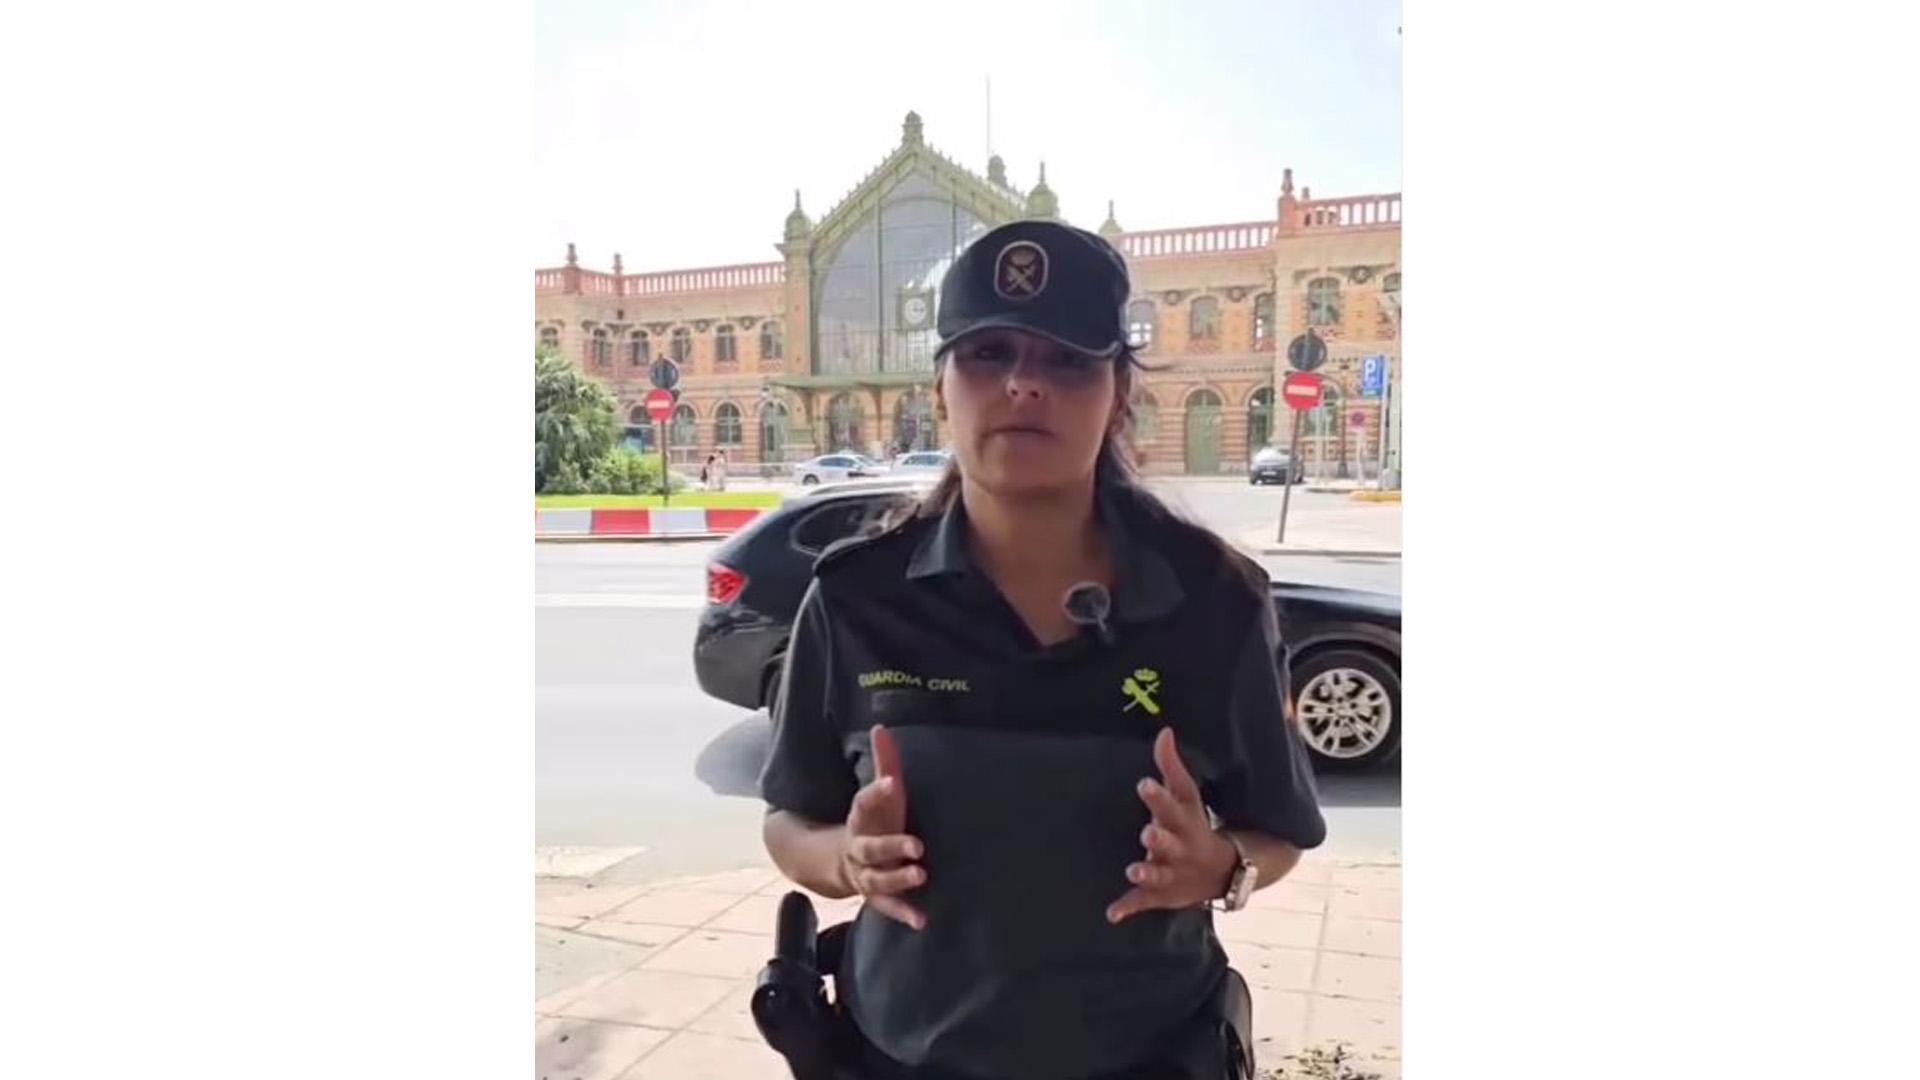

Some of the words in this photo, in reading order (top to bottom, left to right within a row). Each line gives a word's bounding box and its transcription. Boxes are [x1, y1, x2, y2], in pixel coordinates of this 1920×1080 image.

[1364, 359, 1376, 380] P
[858, 670, 922, 688] GUARDIA
[927, 678, 971, 692] CIVIL
